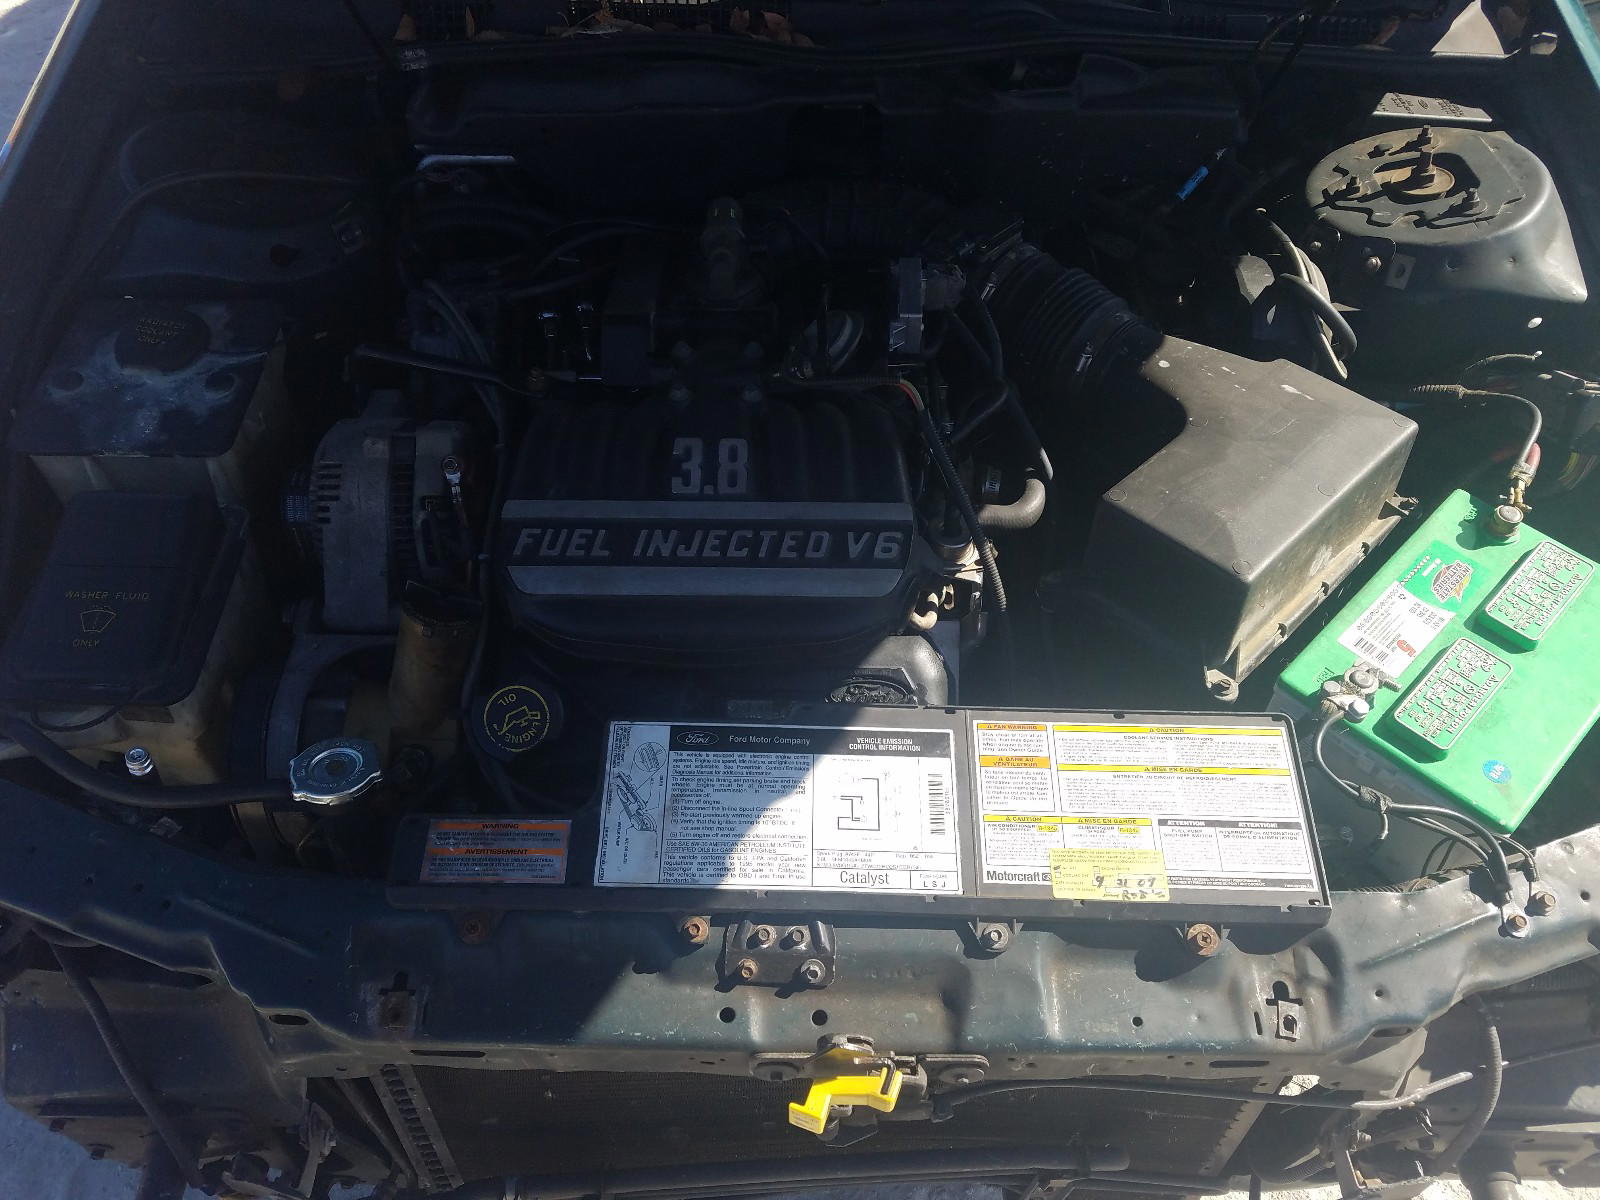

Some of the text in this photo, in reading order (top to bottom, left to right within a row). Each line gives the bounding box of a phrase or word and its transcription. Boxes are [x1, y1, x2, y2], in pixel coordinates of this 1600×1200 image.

[672, 437, 749, 495] 3.8
[512, 527, 904, 560] FUEL INJECTED V6
[1432, 562, 1462, 594] BATTERIES
[1438, 564, 1470, 599] INTERSTATE
[65, 590, 151, 600] WASHER FLUID
[72, 639, 101, 649] ONLY
[498, 692, 517, 706] OIL
[505, 721, 542, 744] ENGINE
[685, 731, 711, 744] Ford
[729, 735, 811, 746] Ford Motor Company
[849, 743, 879, 751] CONTROL
[839, 870, 890, 887] Catalyst
[986, 869, 1041, 883] Motorcraft
